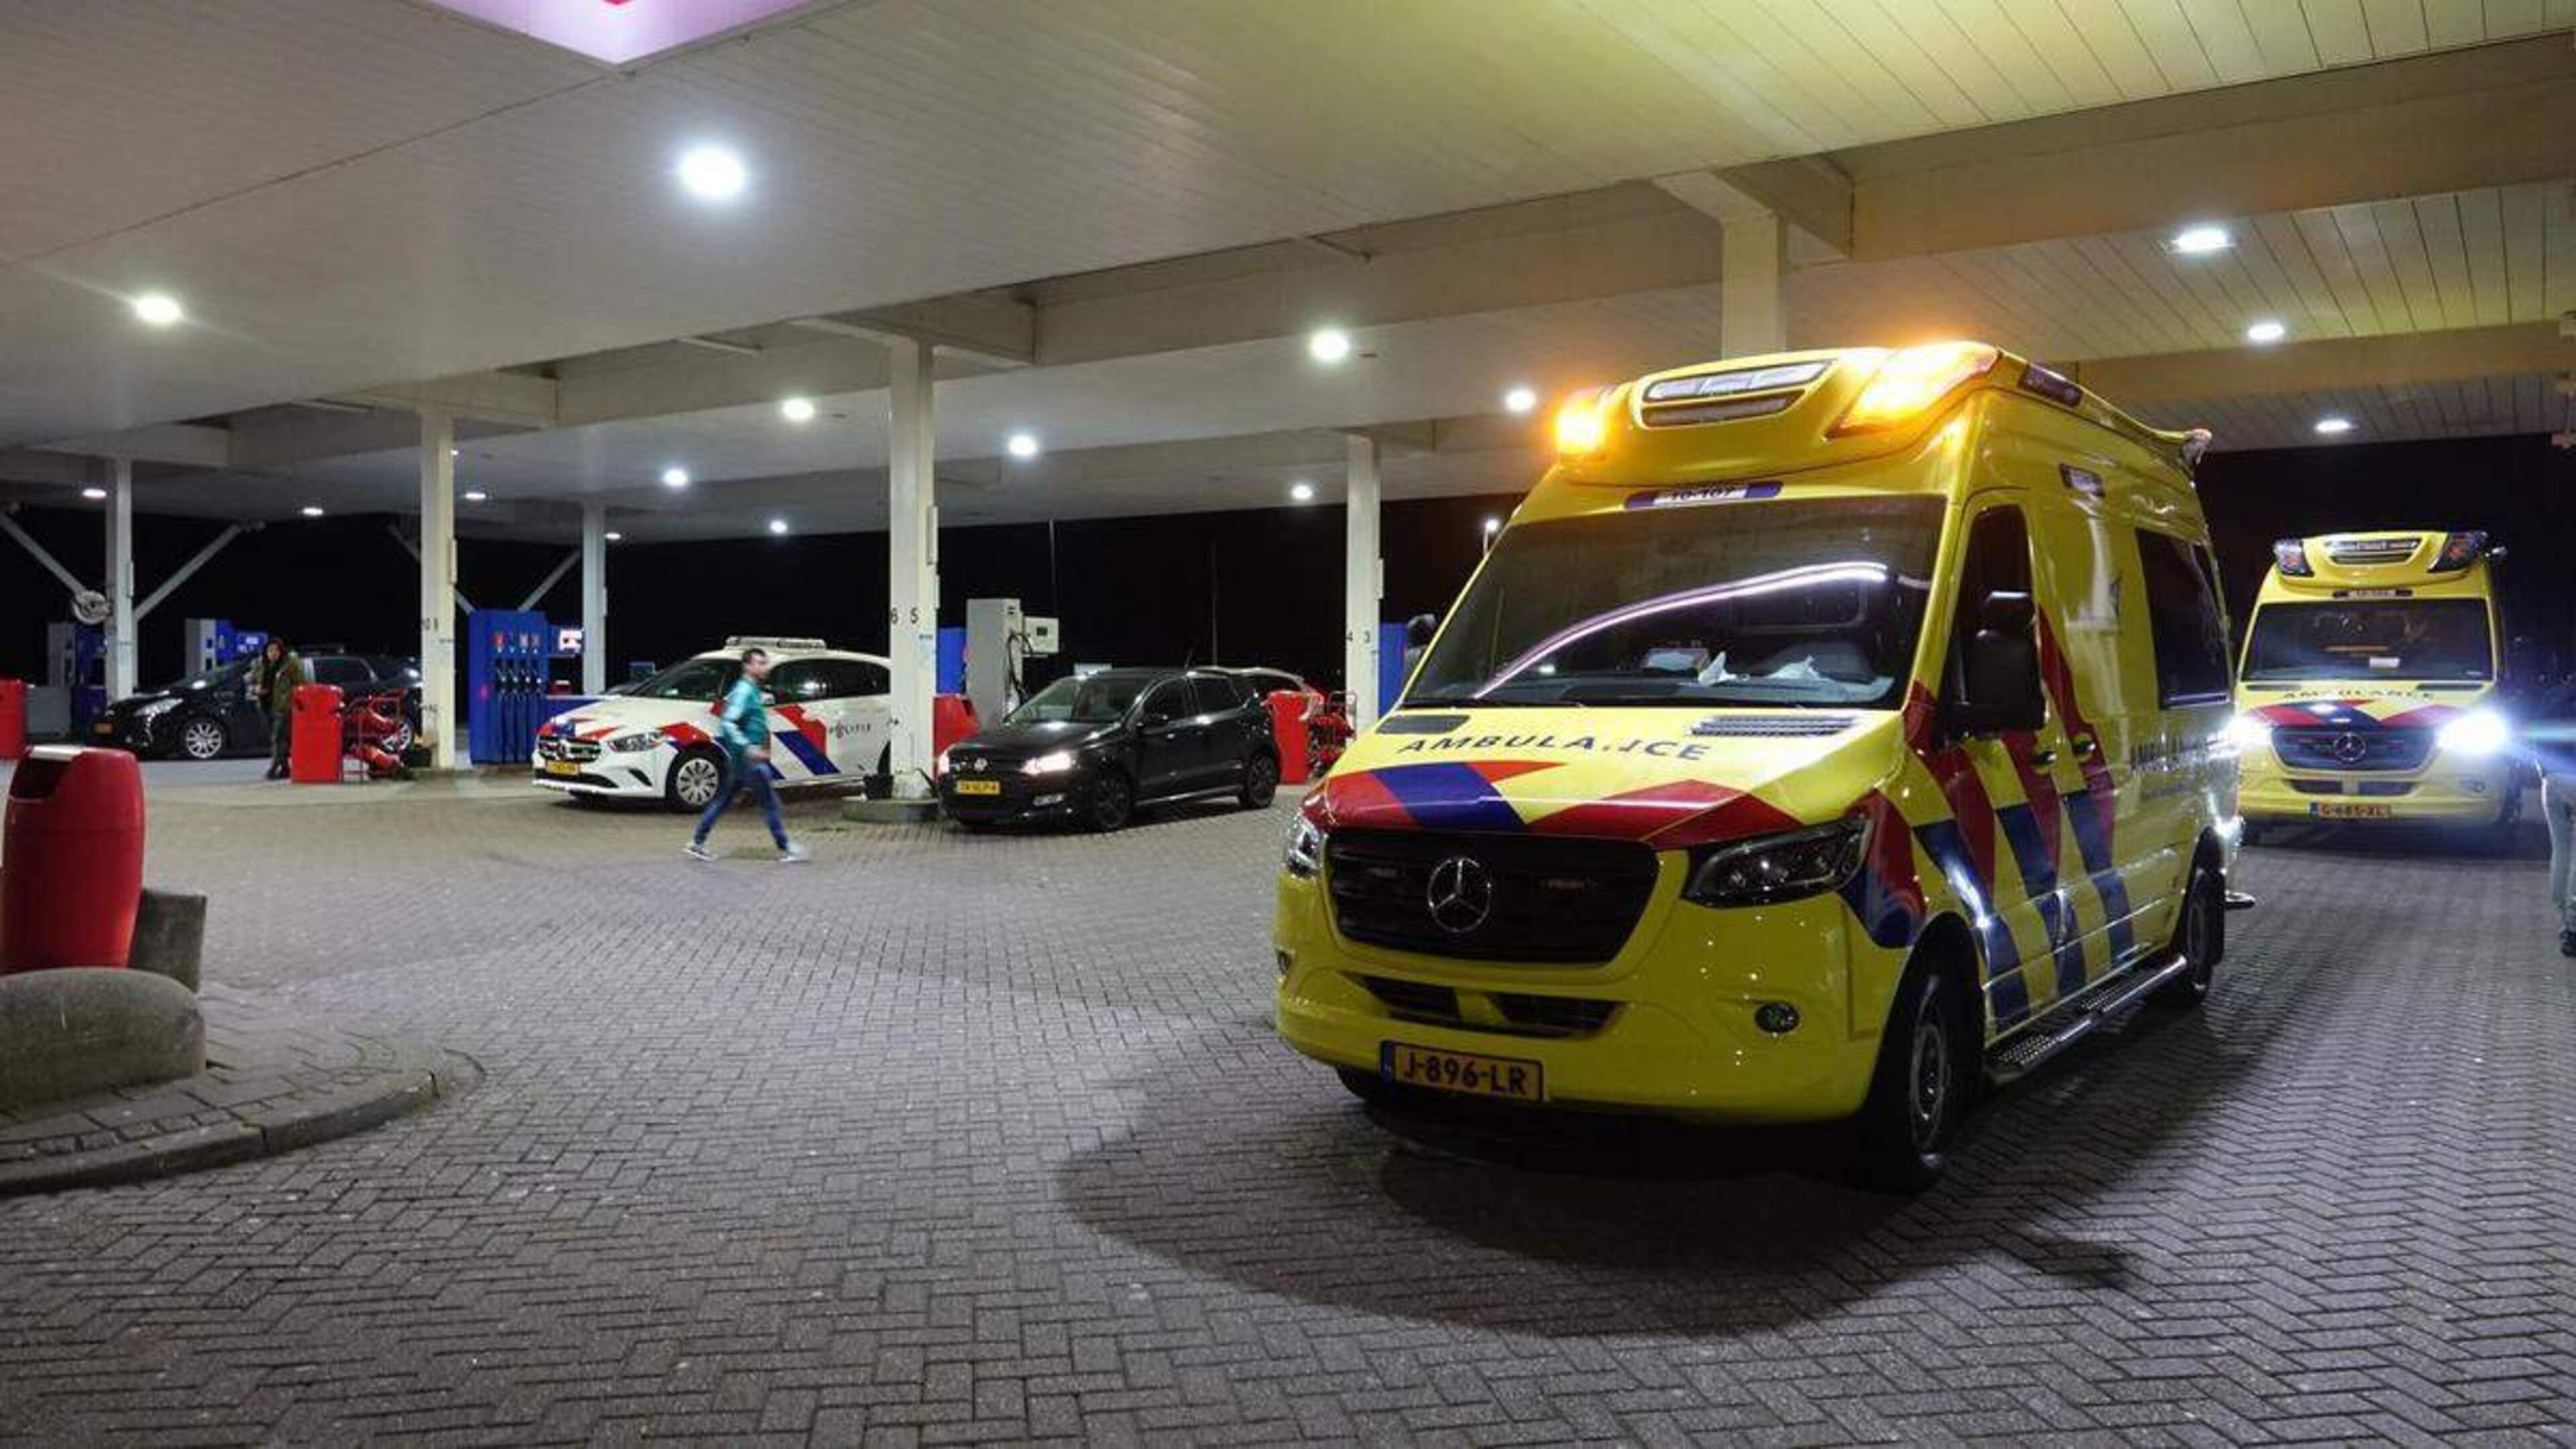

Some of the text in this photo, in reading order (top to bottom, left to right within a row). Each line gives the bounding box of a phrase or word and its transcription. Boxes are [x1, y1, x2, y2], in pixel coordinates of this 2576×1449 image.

[910, 606, 920, 625] 5
[2283, 690, 2432, 700] AMULANCE
[1403, 1052, 1527, 1095] J-896-LR
